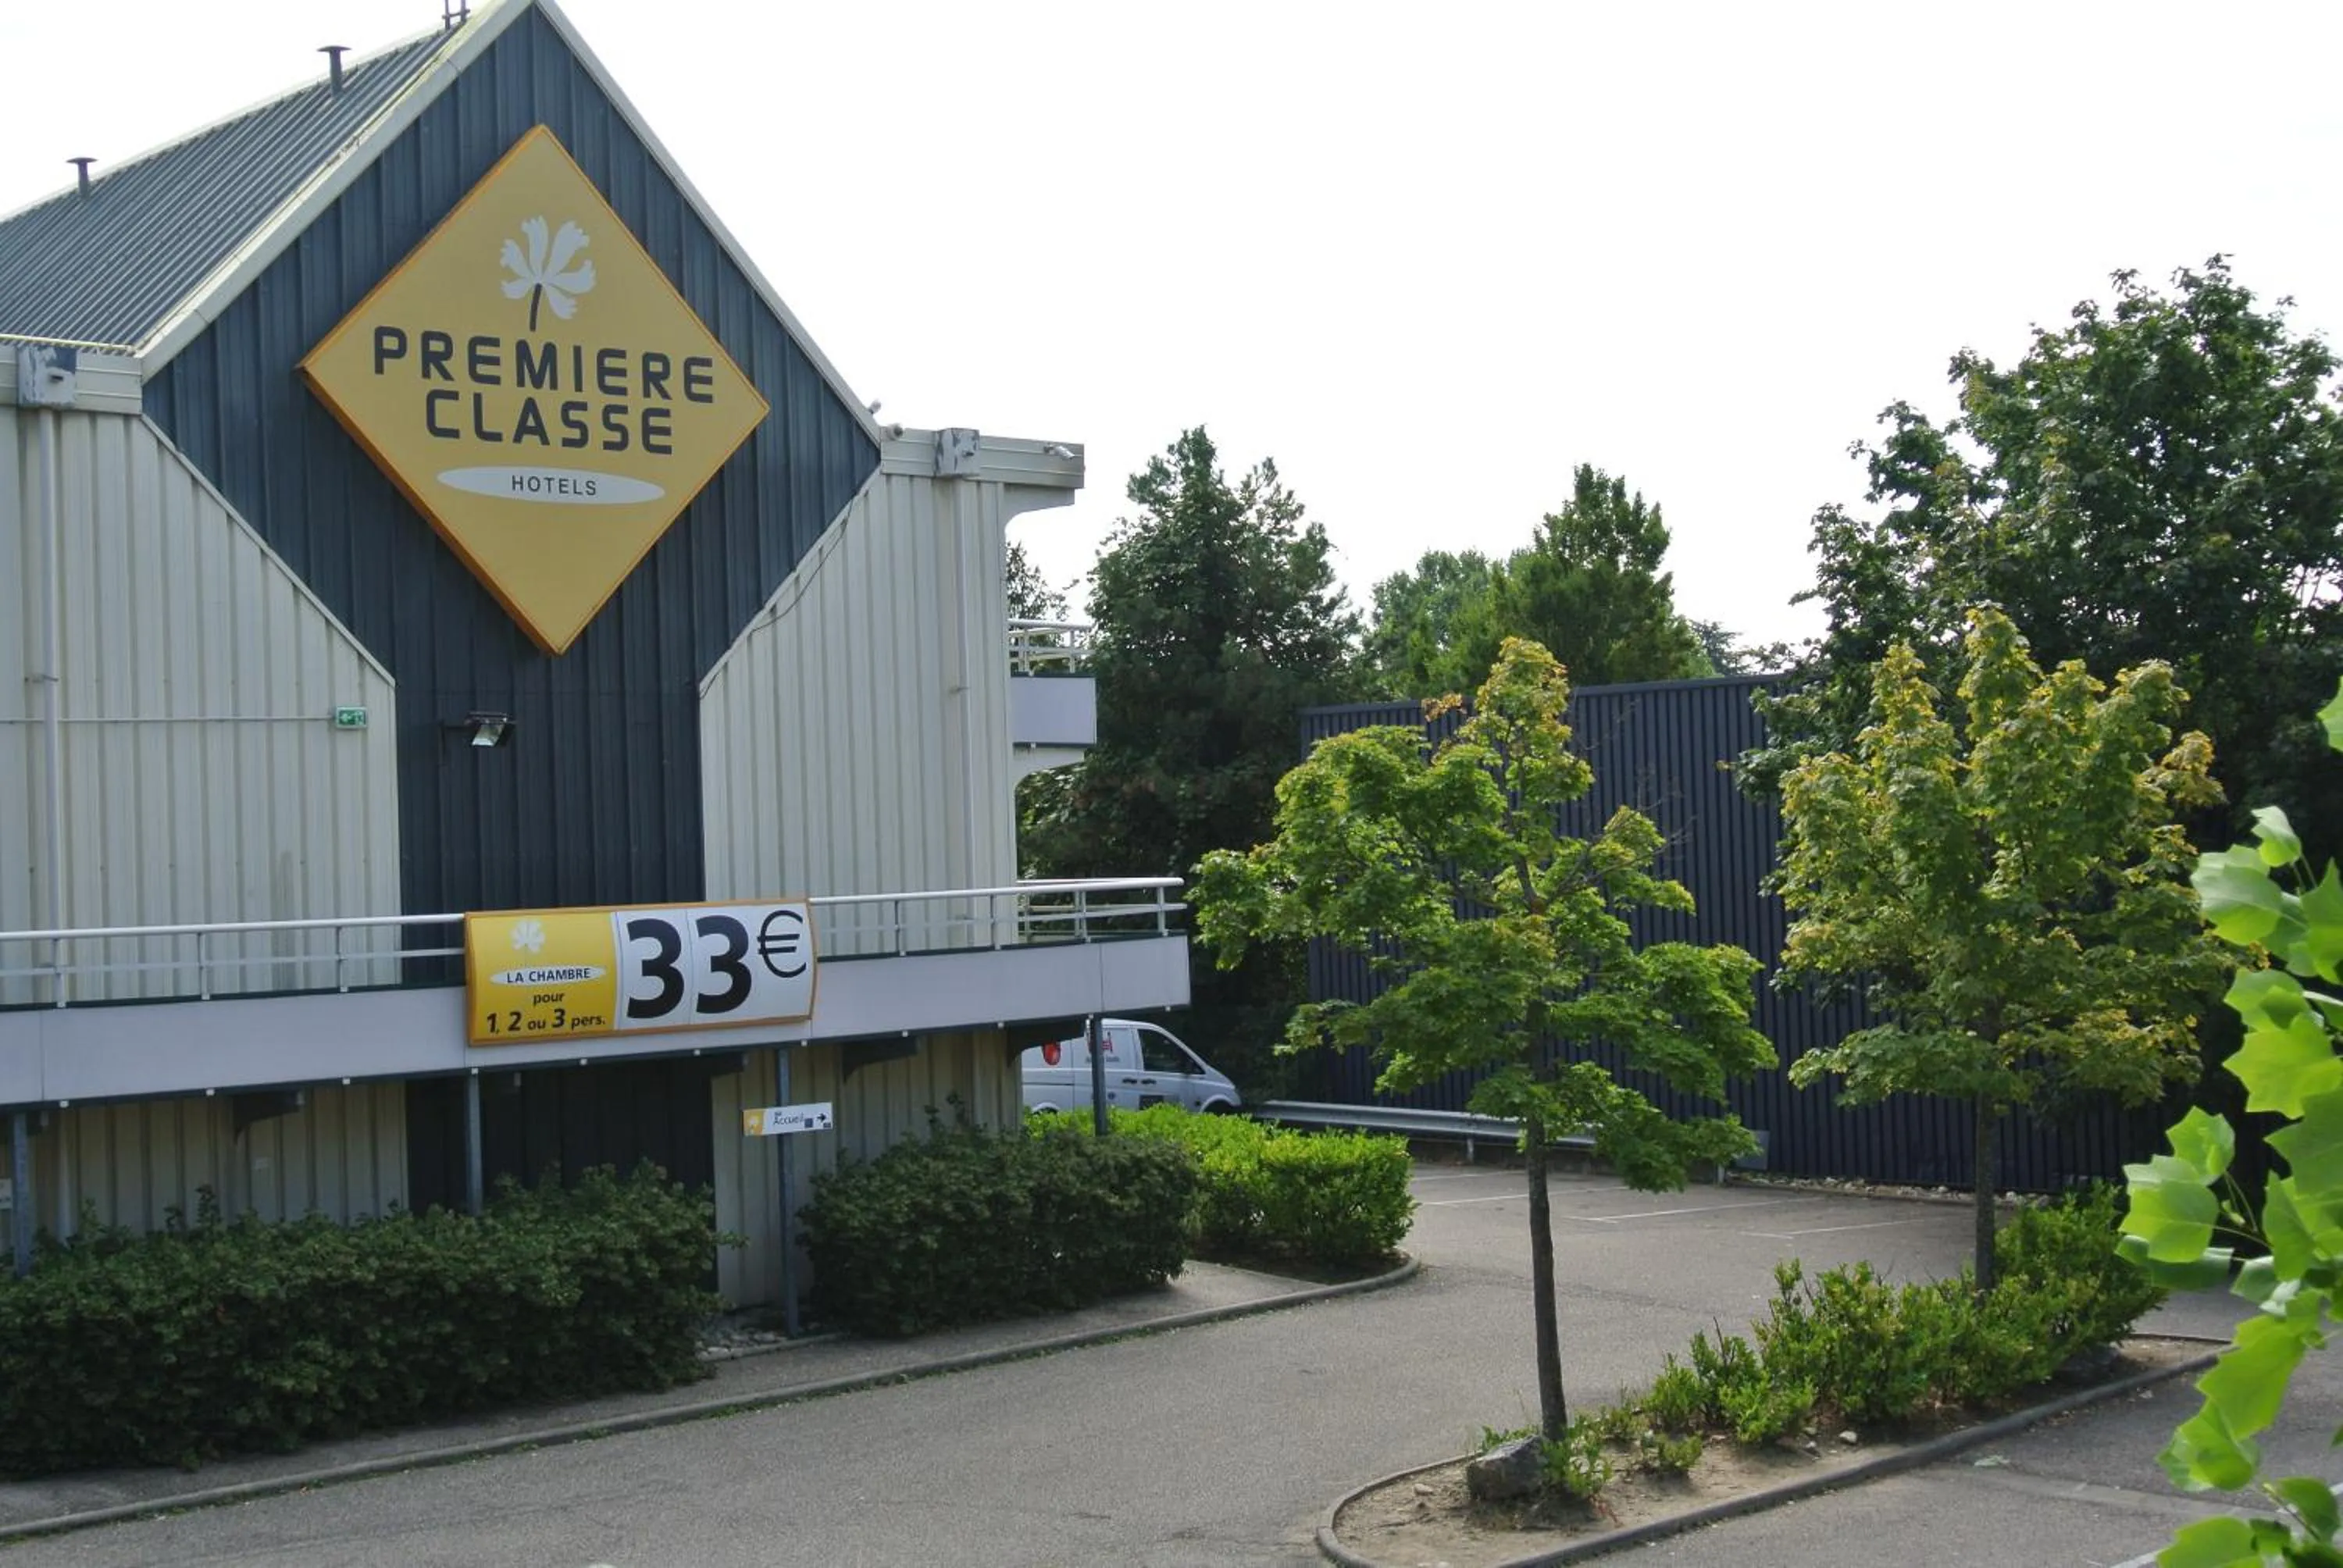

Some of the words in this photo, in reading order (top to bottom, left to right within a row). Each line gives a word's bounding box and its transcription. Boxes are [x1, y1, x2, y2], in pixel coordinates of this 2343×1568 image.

[373, 326, 714, 404] PREMIERE
[426, 389, 673, 455] CLASSE
[512, 475, 598, 497] HOTELS
[507, 972, 524, 984] LA
[529, 968, 591, 982] CHAMBRE
[533, 992, 565, 1006] pour
[508, 1011, 522, 1032] 2
[527, 1021, 546, 1030] ou
[551, 1008, 566, 1028] 3
[571, 1015, 606, 1030] pers.
[773, 1110, 804, 1125] Accueil
